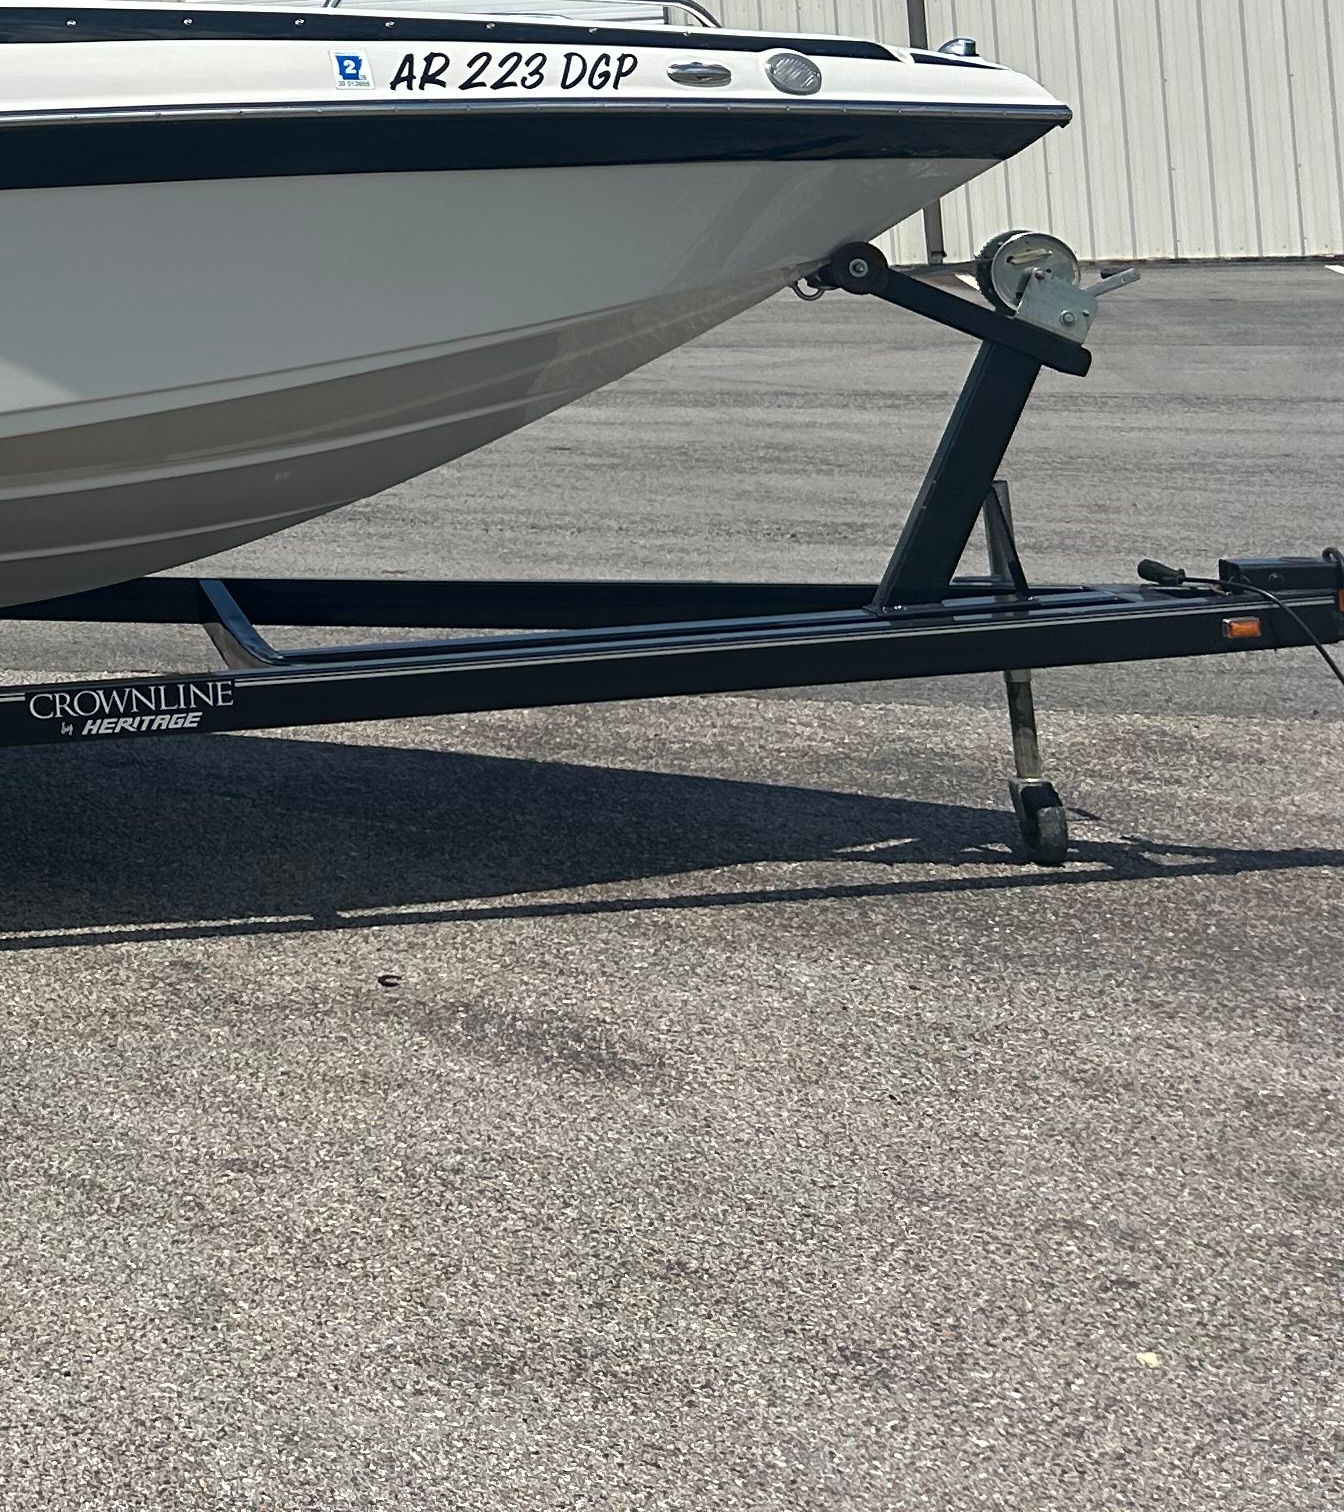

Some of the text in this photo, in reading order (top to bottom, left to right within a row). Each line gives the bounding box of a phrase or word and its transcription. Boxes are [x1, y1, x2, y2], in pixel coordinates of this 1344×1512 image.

[389, 52, 639, 91] AR 223 DGP
[29, 680, 234, 719] CROWNLINE
[81, 712, 203, 736] HERITAGE
